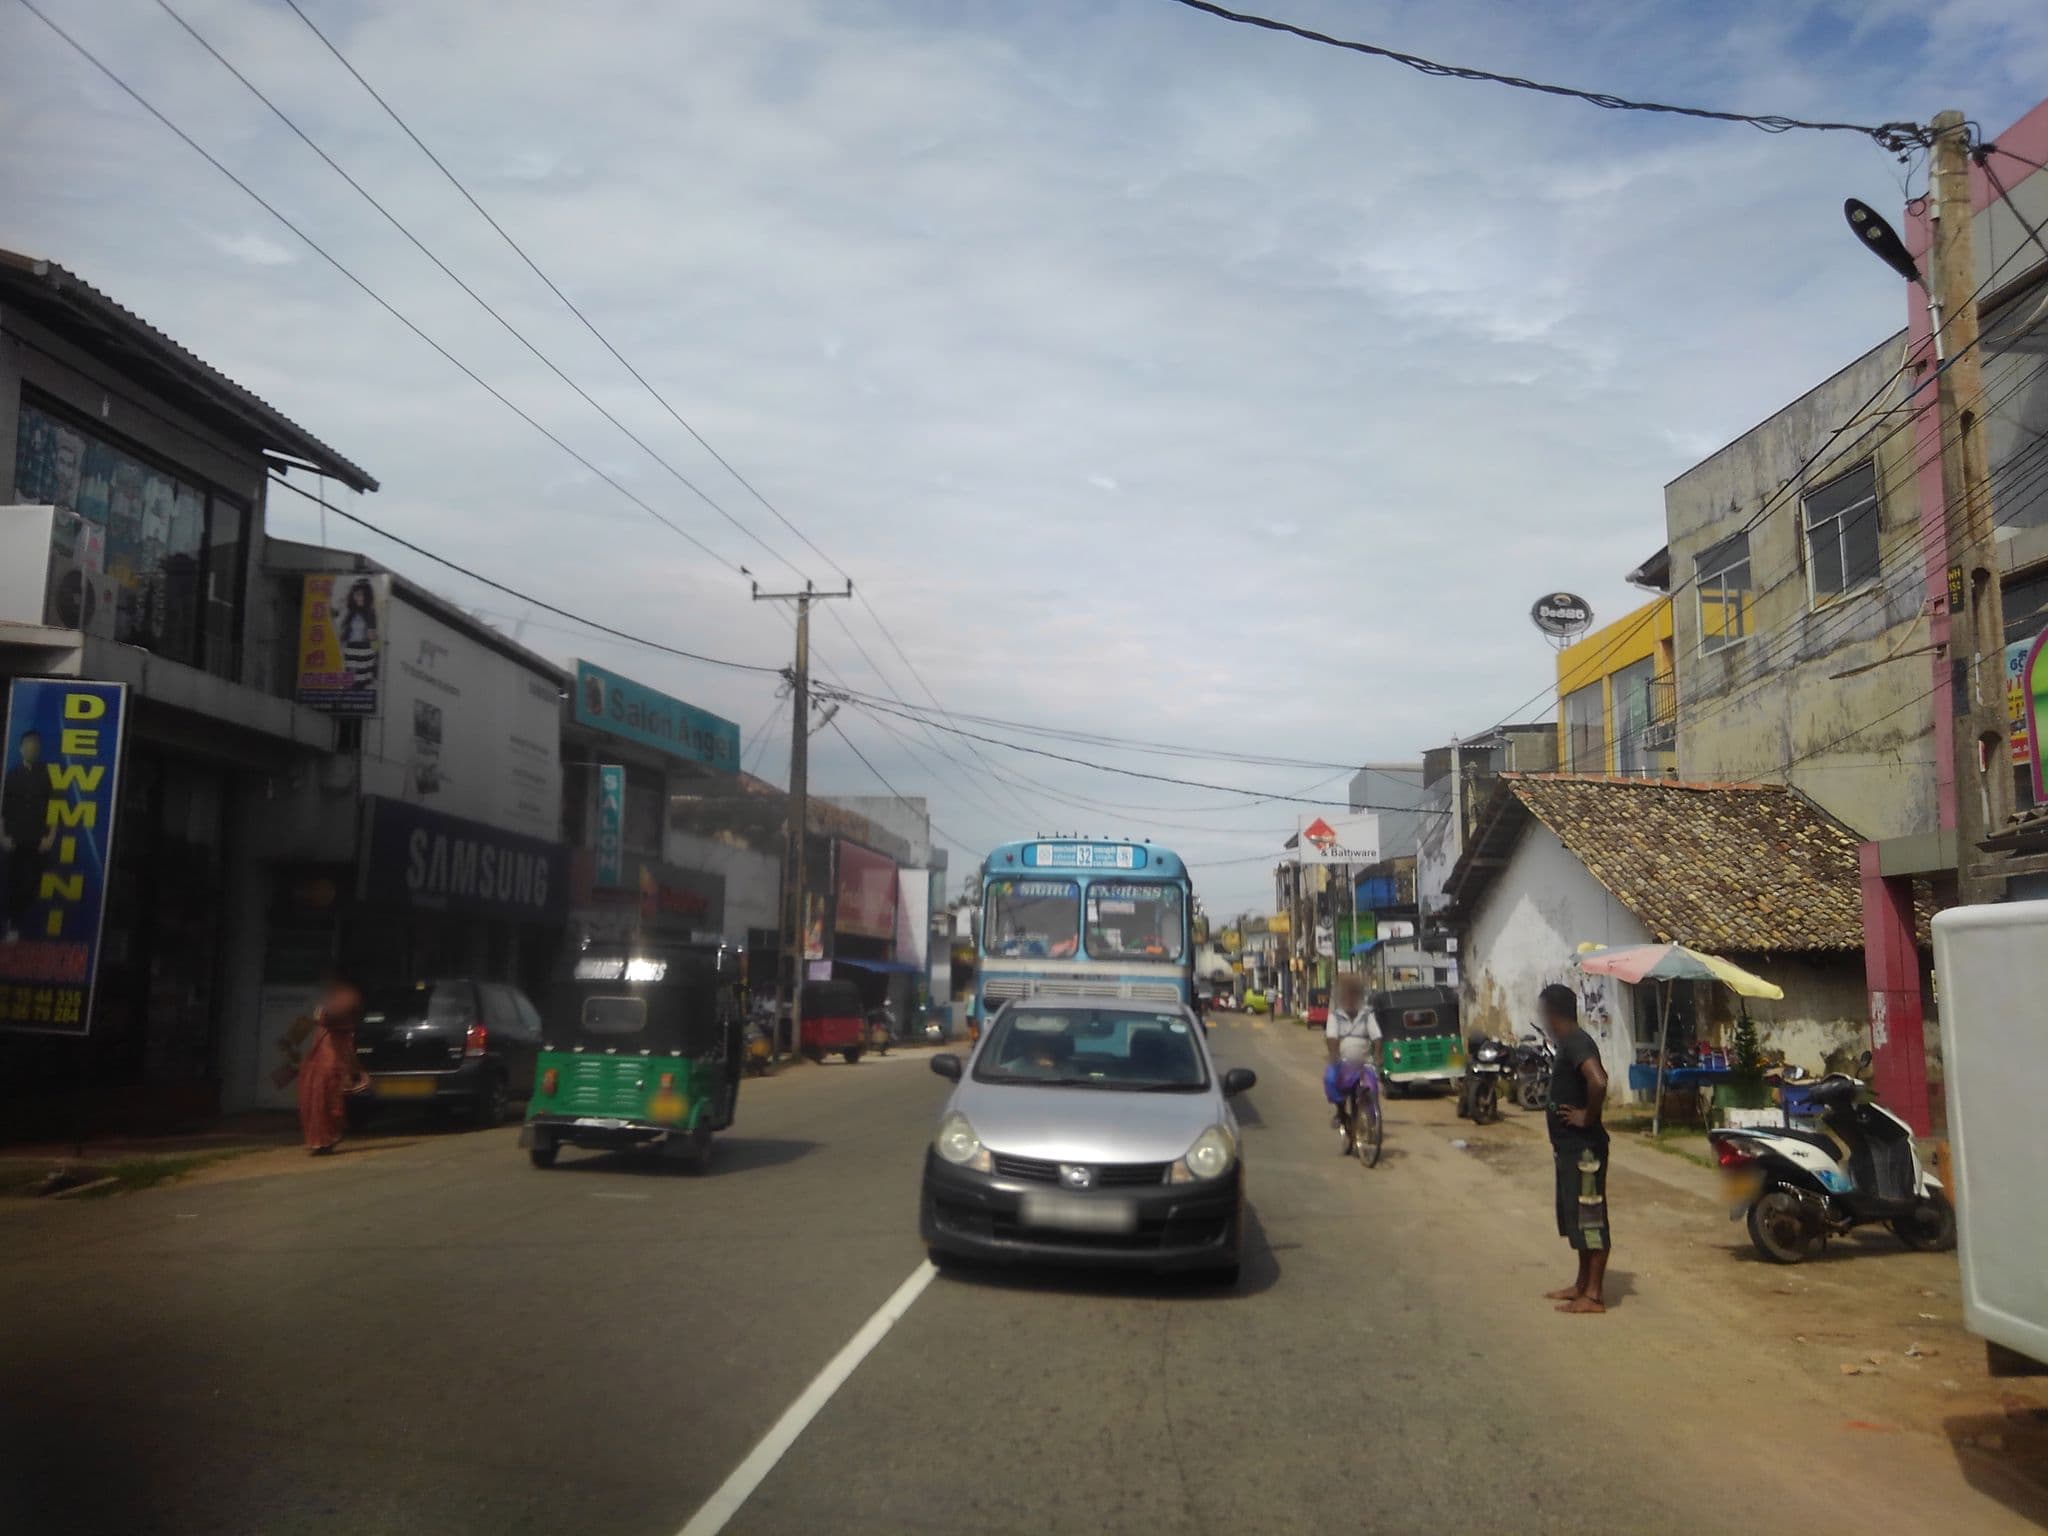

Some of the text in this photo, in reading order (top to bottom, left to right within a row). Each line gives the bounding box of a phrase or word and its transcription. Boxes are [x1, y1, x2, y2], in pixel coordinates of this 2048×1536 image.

[611, 687, 673, 738] Salon
[677, 715, 735, 762] Angel
[40, 693, 105, 936] DEWMINI
[601, 774, 618, 871] SALON
[405, 829, 548, 907] SAMSUNG
[1079, 847, 1092, 865] 32
